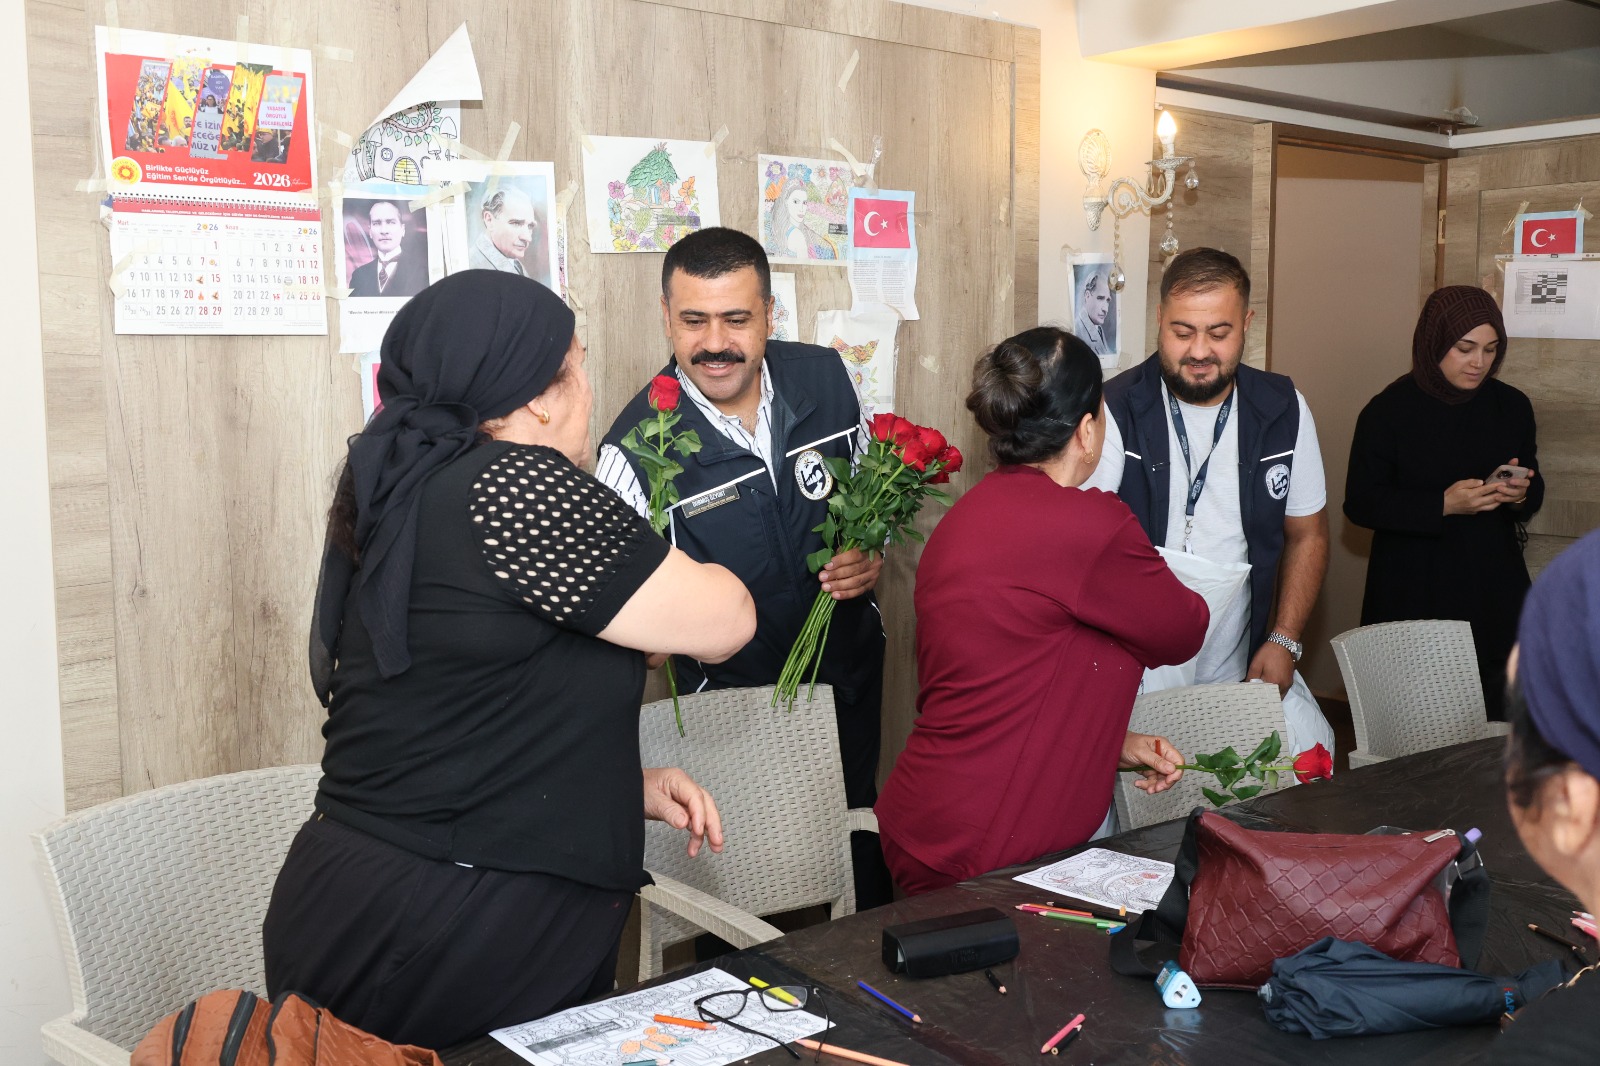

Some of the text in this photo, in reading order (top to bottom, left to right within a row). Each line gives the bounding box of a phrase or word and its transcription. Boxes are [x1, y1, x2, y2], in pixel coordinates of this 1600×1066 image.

[175, 166, 209, 175] Güçlüyüz
[253, 172, 291, 187] 2026
[275, 243, 278, 251] 2
[288, 244, 291, 252] 3
[300, 244, 304, 252] 4
[313, 245, 317, 253] 5
[144, 256, 148, 264] 3
[158, 256, 162, 264] 4
[173, 256, 177, 265] 5
[187, 257, 191, 265] 6
[201, 257, 204, 265] 7
[237, 259, 240, 267] 6
[250, 259, 253, 267] 7
[263, 259, 267, 267] 8
[310, 260, 318, 269] 12
[130, 272, 220, 282] 9 10 11 12 13 15
[233, 274, 241, 283] 13
[247, 275, 255, 283] 14
[260, 275, 268, 283] 15
[273, 275, 281, 284] 16
[311, 276, 319, 284] 19
[127, 289, 193, 298] 16 17 18 19 20
[234, 290, 242, 299] 20
[247, 291, 255, 299] 21
[260, 291, 269, 299] 22
[300, 292, 307, 300] 25
[157, 306, 165, 315] 25
[171, 306, 180, 315] 26
[185, 307, 193, 315] 27
[199, 307, 208, 315] 28
[213, 307, 221, 315] 29
[234, 307, 283, 315] 27 28 29 30
